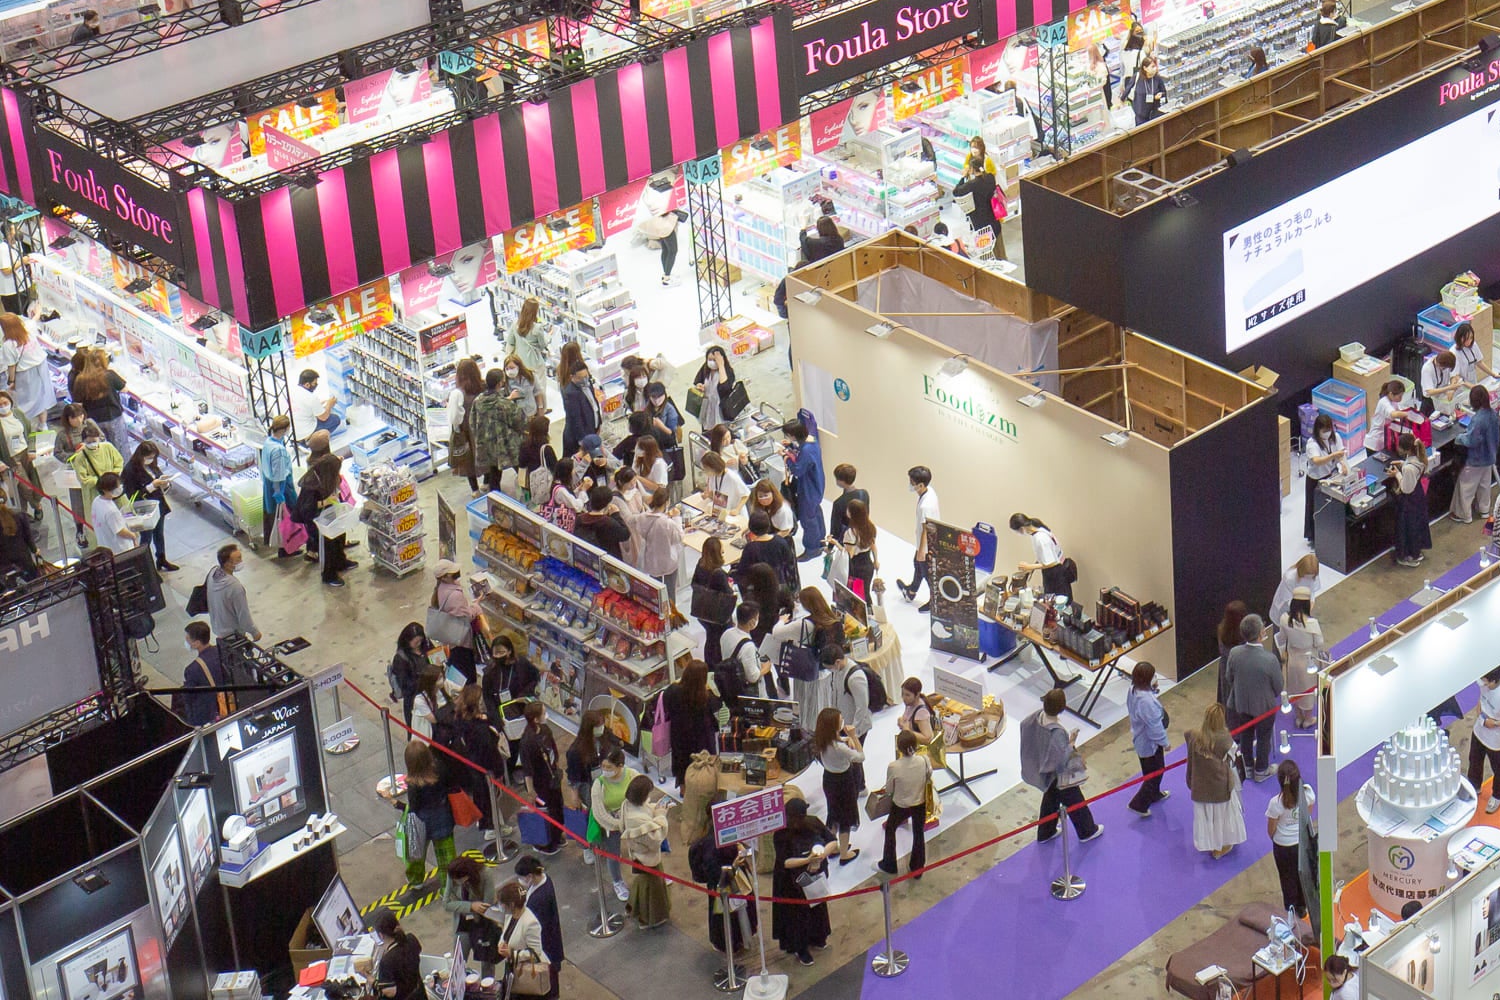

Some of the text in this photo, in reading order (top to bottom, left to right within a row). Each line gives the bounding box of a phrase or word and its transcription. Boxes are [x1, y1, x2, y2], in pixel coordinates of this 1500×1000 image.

[1052, 25, 1066, 44] A2
[804, 21, 888, 75] Foula
[1439, 70, 1486, 106] Foula
[685, 162, 699, 179] A3
[701, 160, 720, 180] A3
[47, 148, 174, 245] Foula Store
[1243, 207, 1313, 249] 男性のまつ毛の
[1244, 211, 1332, 263] ナチュラルカールも
[1247, 288, 1304, 329] M2 サイズ使用
[241, 332, 255, 353] A4
[258, 330, 281, 355] A4
[272, 705, 299, 721] Wax
[262, 721, 288, 739] JAPAN
[716, 791, 782, 824] お会計
[1383, 872, 1423, 885] MERCURY
